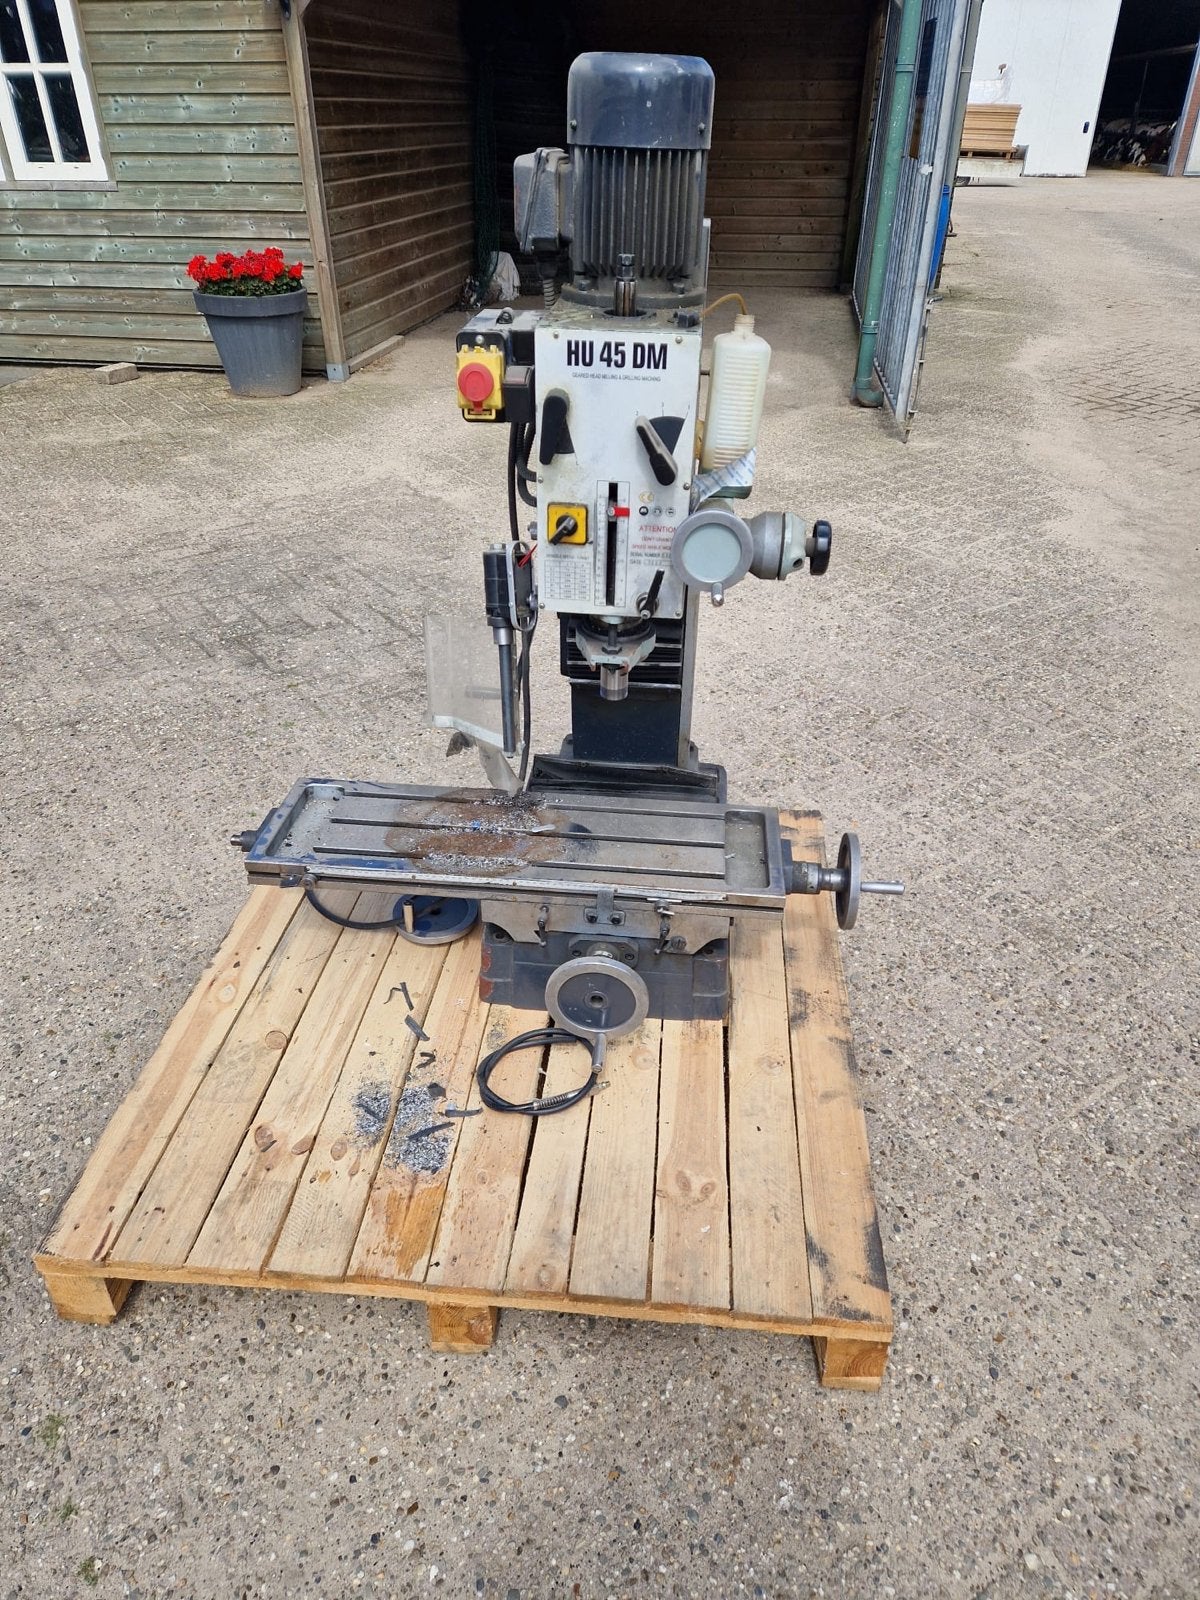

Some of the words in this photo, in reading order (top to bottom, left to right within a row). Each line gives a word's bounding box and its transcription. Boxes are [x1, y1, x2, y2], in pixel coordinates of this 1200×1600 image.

[567, 339, 594, 367] HU
[599, 341, 626, 368] 45
[632, 342, 668, 370] DM
